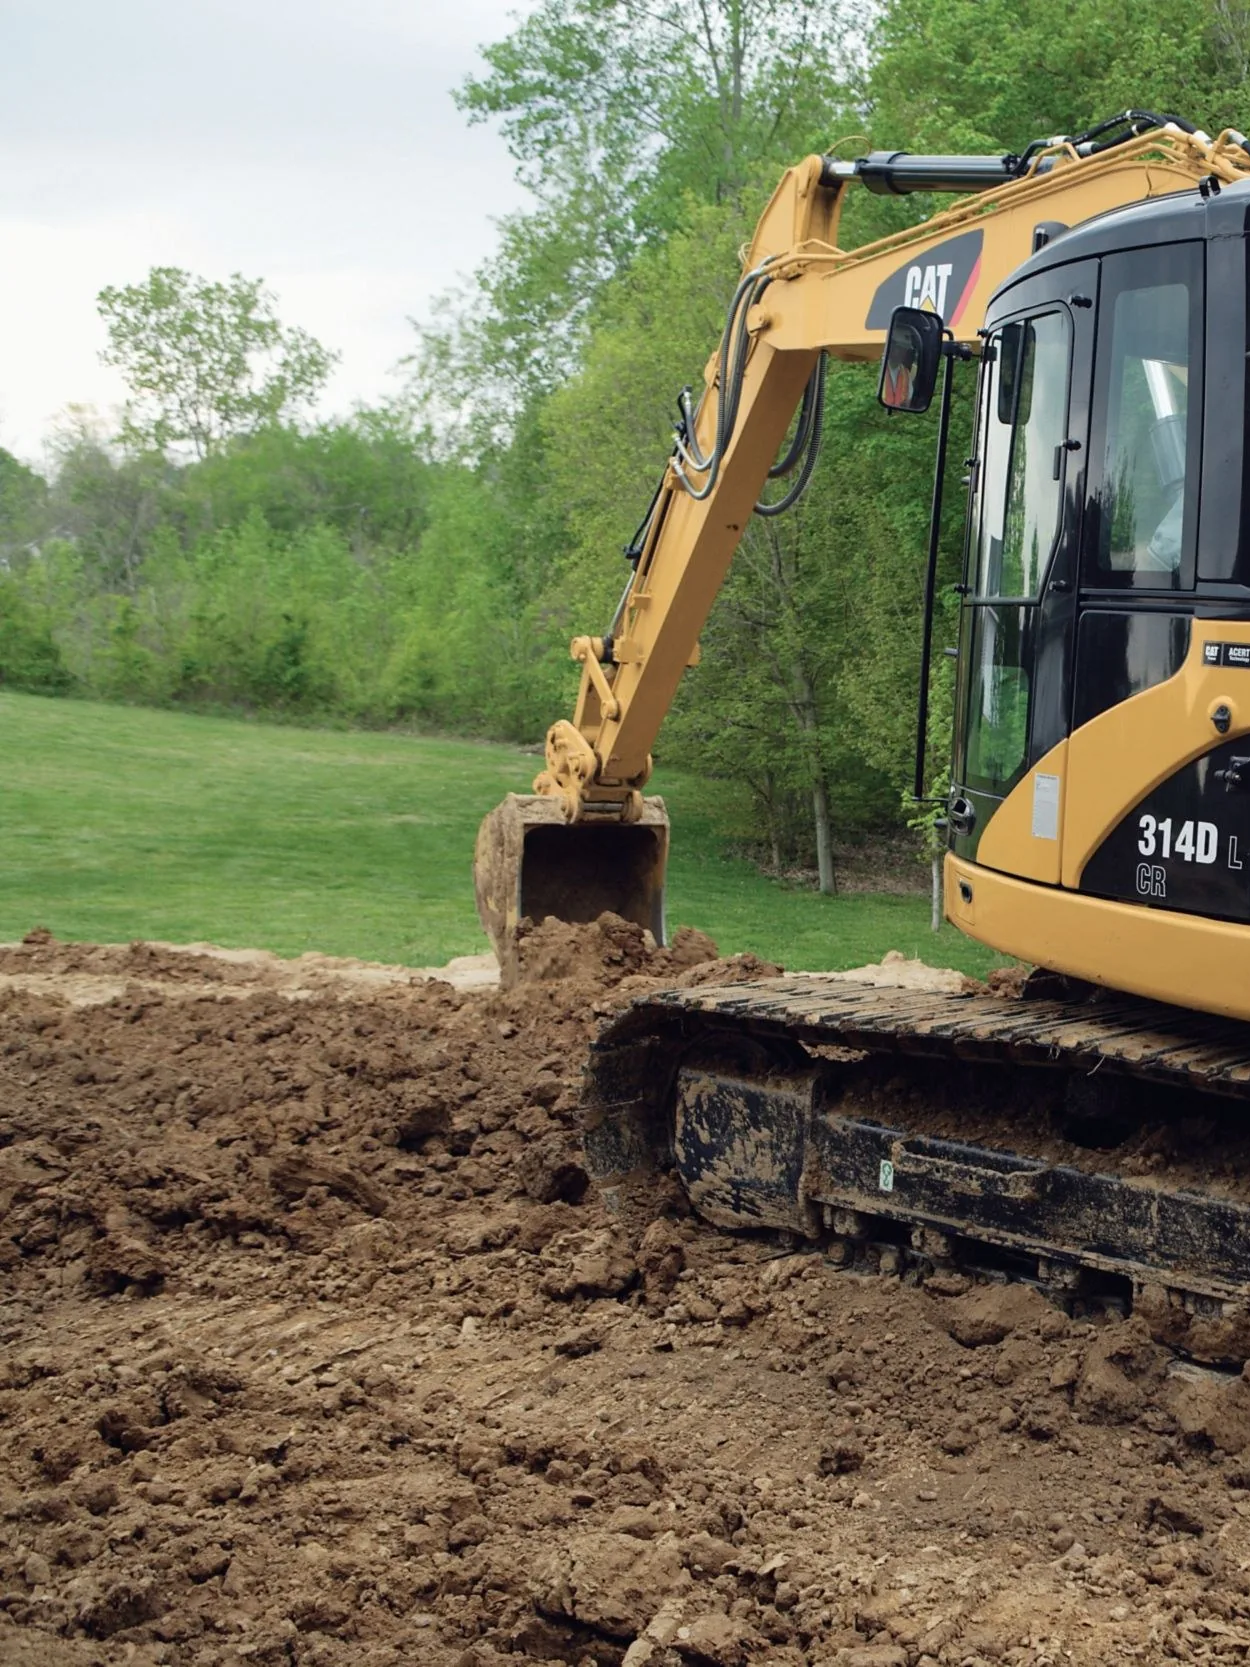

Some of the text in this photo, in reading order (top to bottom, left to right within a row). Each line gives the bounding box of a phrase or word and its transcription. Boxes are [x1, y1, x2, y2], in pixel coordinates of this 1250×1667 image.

[904, 263, 953, 320] CAT
[1205, 645, 1219, 657] CAT
[1138, 814, 1242, 870] 314D L
[1136, 862, 1166, 898] CR
